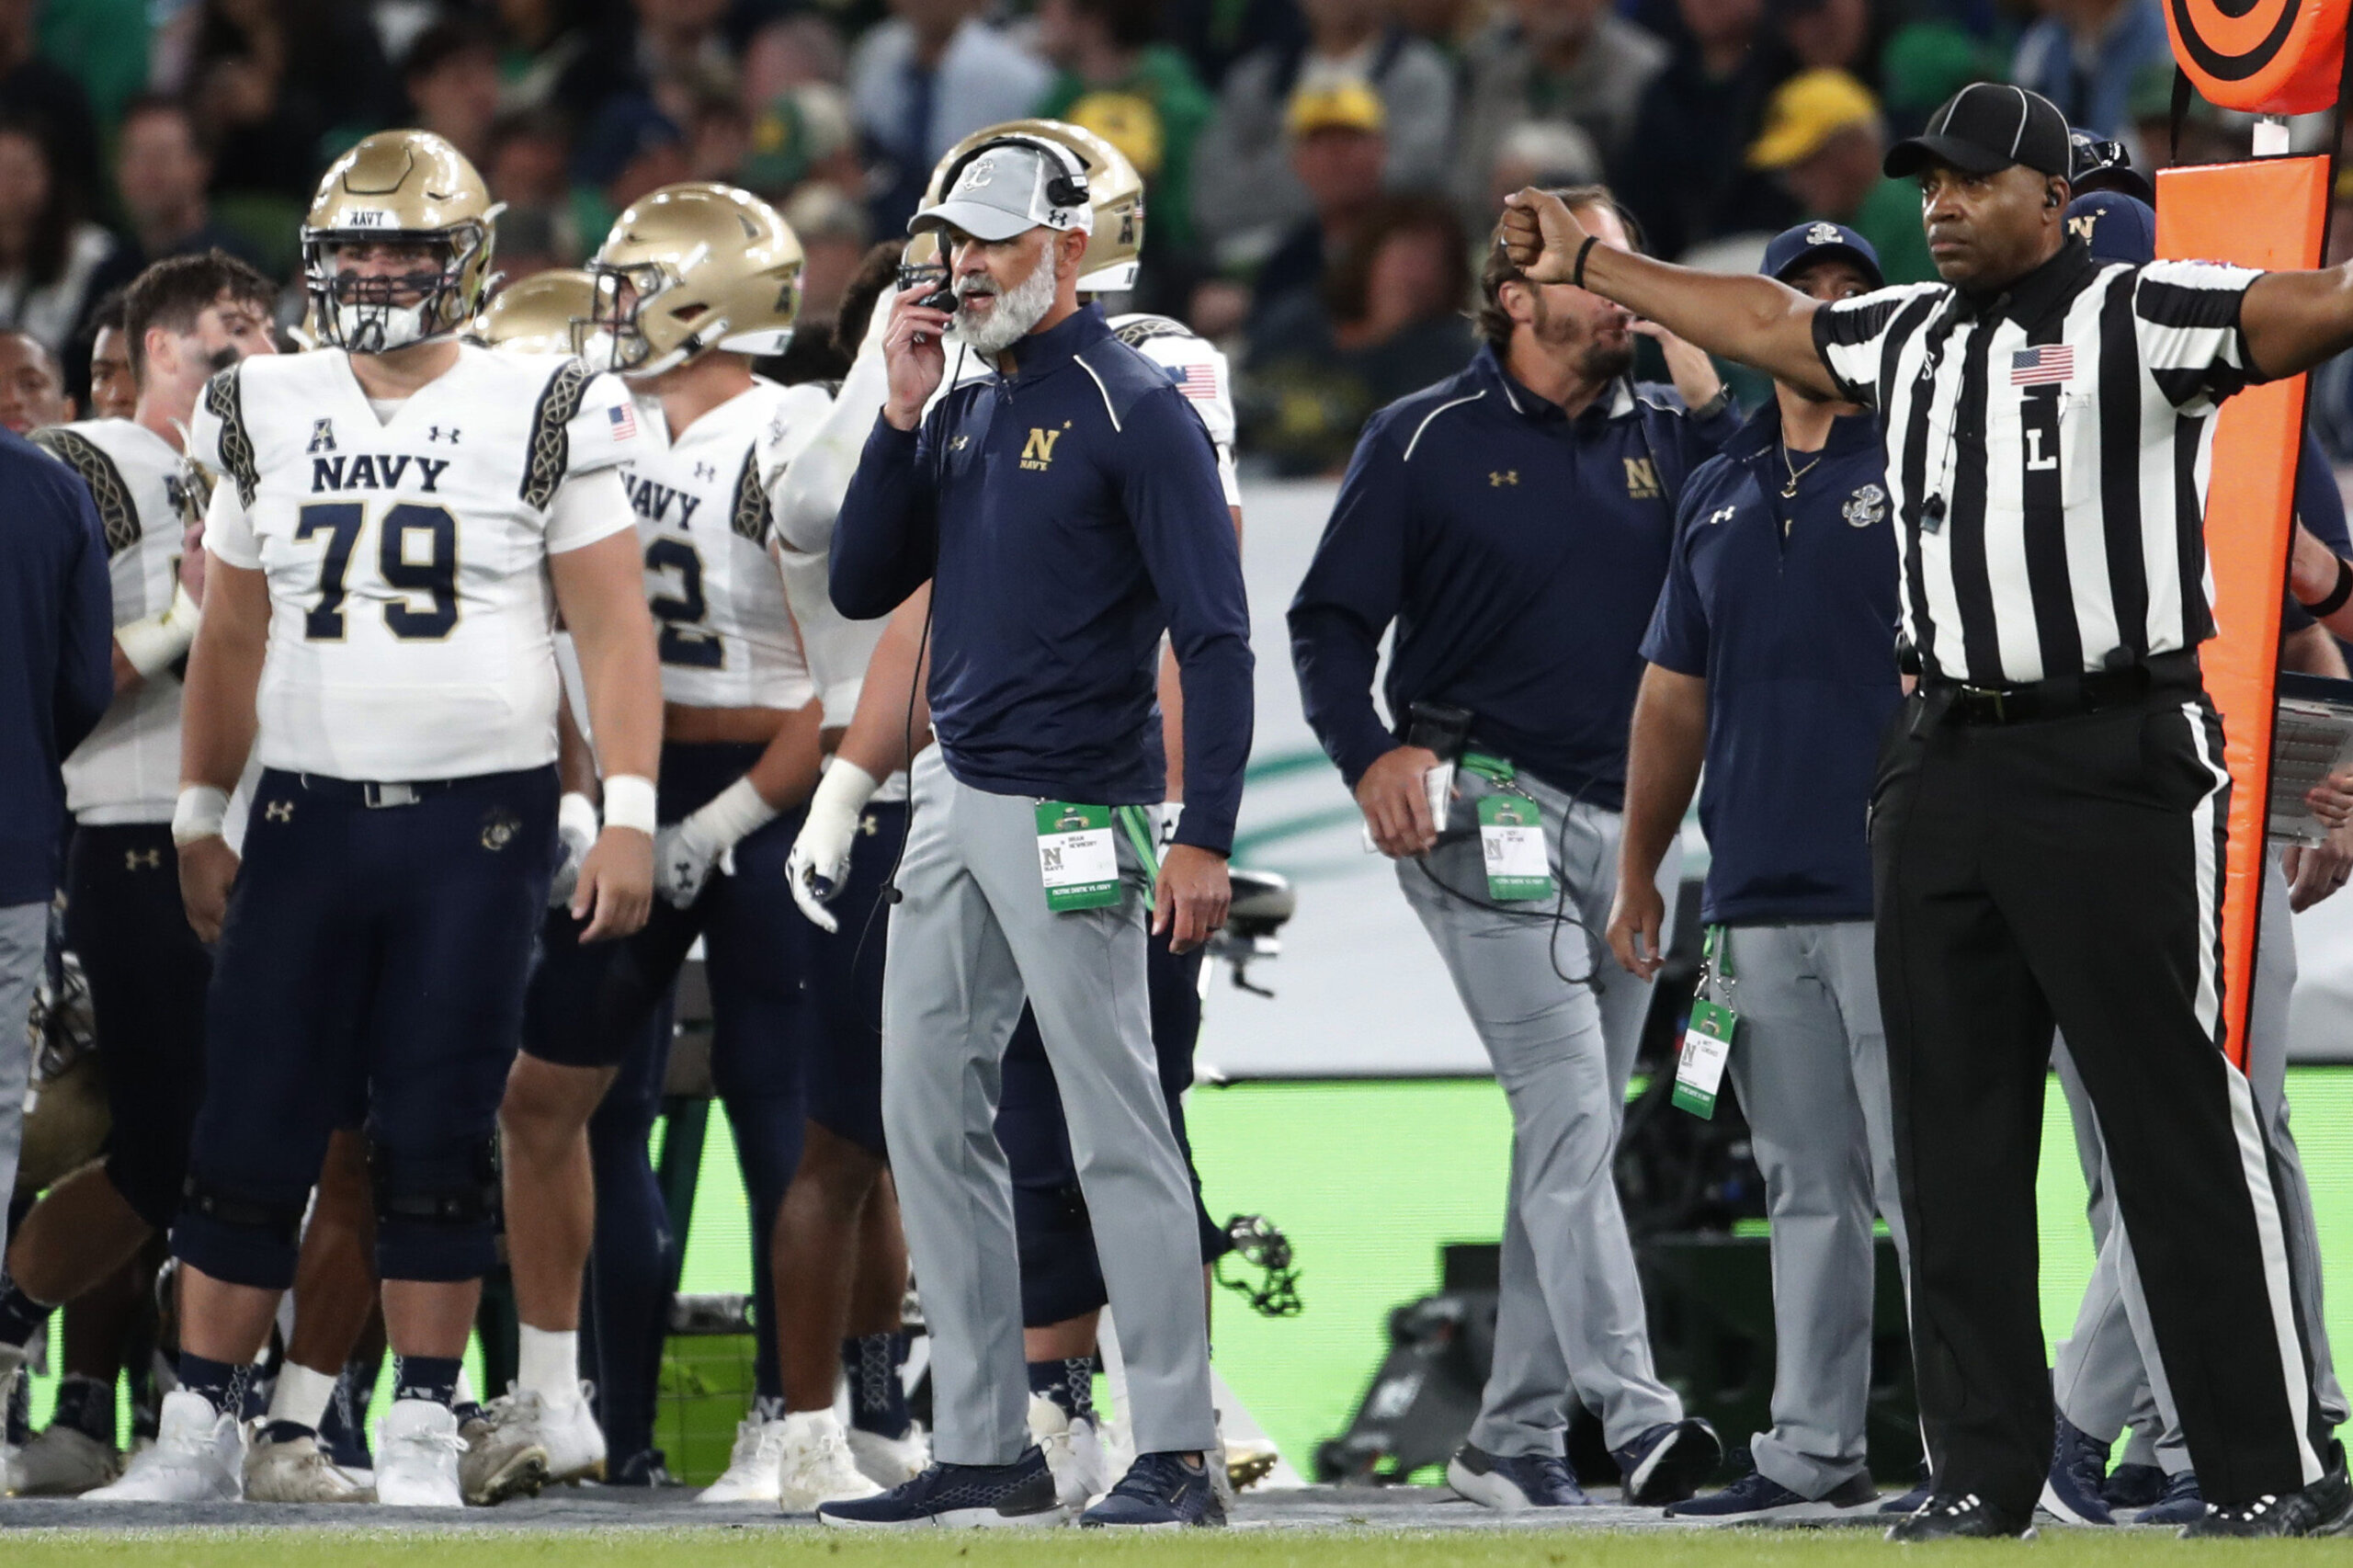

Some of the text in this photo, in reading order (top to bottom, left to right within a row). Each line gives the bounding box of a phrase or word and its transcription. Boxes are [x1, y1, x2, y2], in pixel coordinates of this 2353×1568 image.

[350, 211, 383, 226] NAVY
[2068, 216, 2097, 238] N
[306, 417, 336, 454] A
[1021, 428, 1061, 461] N
[2026, 428, 2058, 471] L
[311, 454, 450, 493] NAVY
[1019, 460, 1048, 471] NAVY
[1622, 457, 1658, 489] N
[292, 499, 461, 642] 79
[1041, 846, 1062, 865] N
